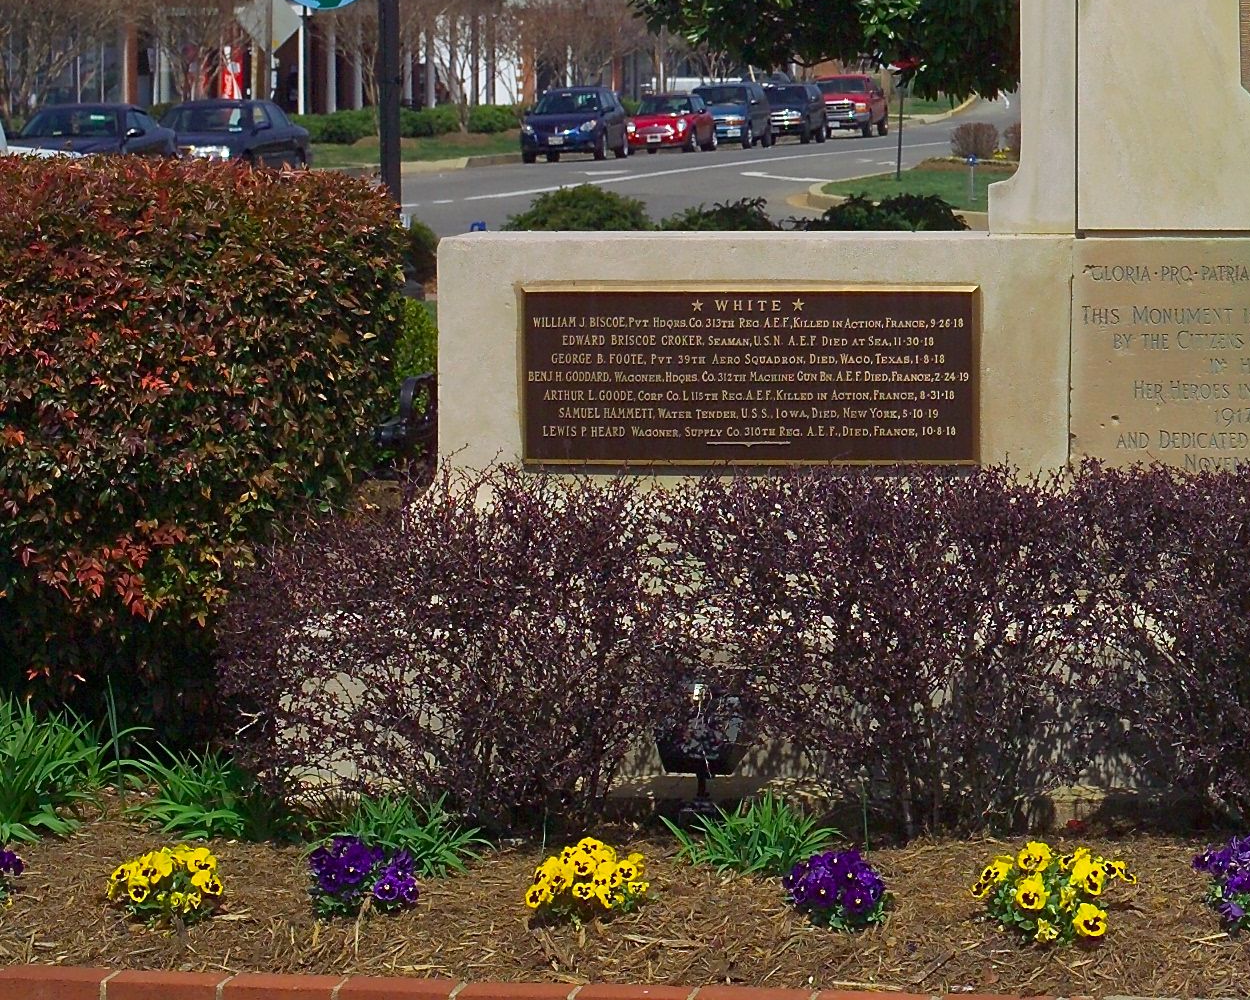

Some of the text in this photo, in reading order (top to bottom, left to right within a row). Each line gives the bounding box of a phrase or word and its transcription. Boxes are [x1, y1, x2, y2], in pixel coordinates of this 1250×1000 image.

[1201, 266, 1249, 284] PATRIA
[715, 299, 782, 310] WHITE
[1082, 306, 1120, 324] THIS
[1133, 306, 1233, 324] MONUMENT
[533, 316, 576, 327] WILLIAM
[793, 318, 829, 328] KILLED
[562, 335, 605, 345] EDWARD
[611, 335, 656, 345] BRISCOE
[822, 336, 848, 345] DIED
[1113, 334, 1134, 349] BY
[1141, 334, 1169, 350] THE
[551, 354, 592, 364] GEORGE
[711, 354, 741, 364] AERO
[749, 371, 795, 381] MACHINE
[796, 371, 817, 381] GUN
[544, 390, 584, 400] ARTHUR
[776, 391, 813, 400] KILLED
[1134, 381, 1166, 403] HER
[1170, 381, 1230, 401] HEROES
[558, 408, 600, 418] SAMUEL
[658, 408, 693, 418] WATER
[843, 408, 868, 418] NEW
[543, 427, 577, 437] LEWIS
[591, 427, 625, 436] HEARD
[684, 427, 723, 436] SUPPLY
[1116, 433, 1149, 449] AND
[1159, 431, 1249, 449] DEDICATED
